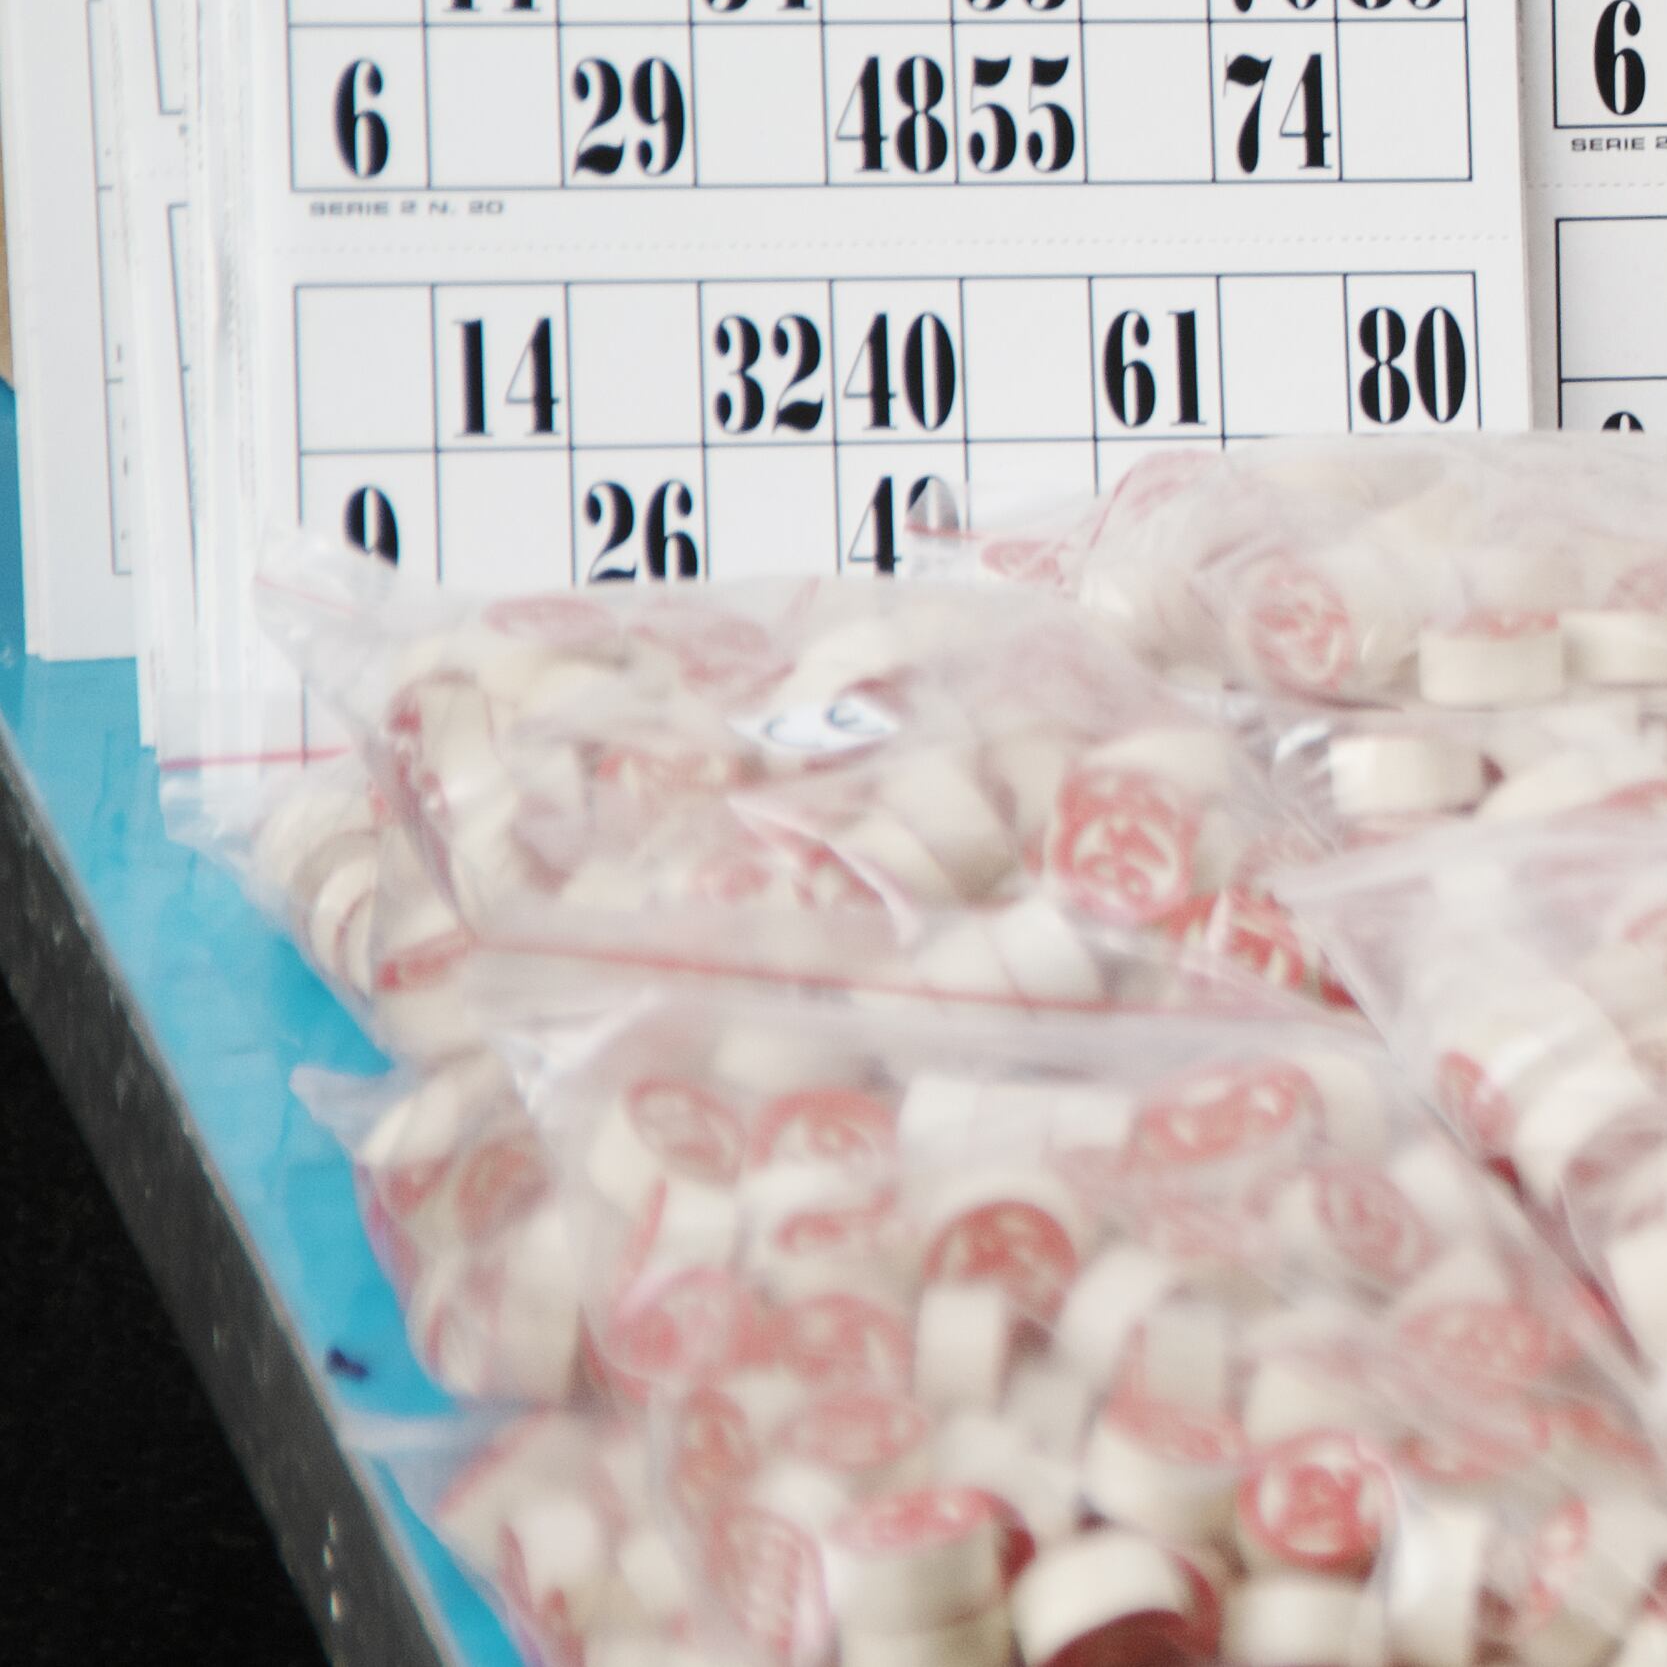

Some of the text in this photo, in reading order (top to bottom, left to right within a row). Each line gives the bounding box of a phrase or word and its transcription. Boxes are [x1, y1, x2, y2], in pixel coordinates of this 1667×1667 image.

[1571, 138, 1644, 152] SERIE
[455, 305, 1468, 438] 14 32 40 61 80
[585, 479, 697, 582] 26
